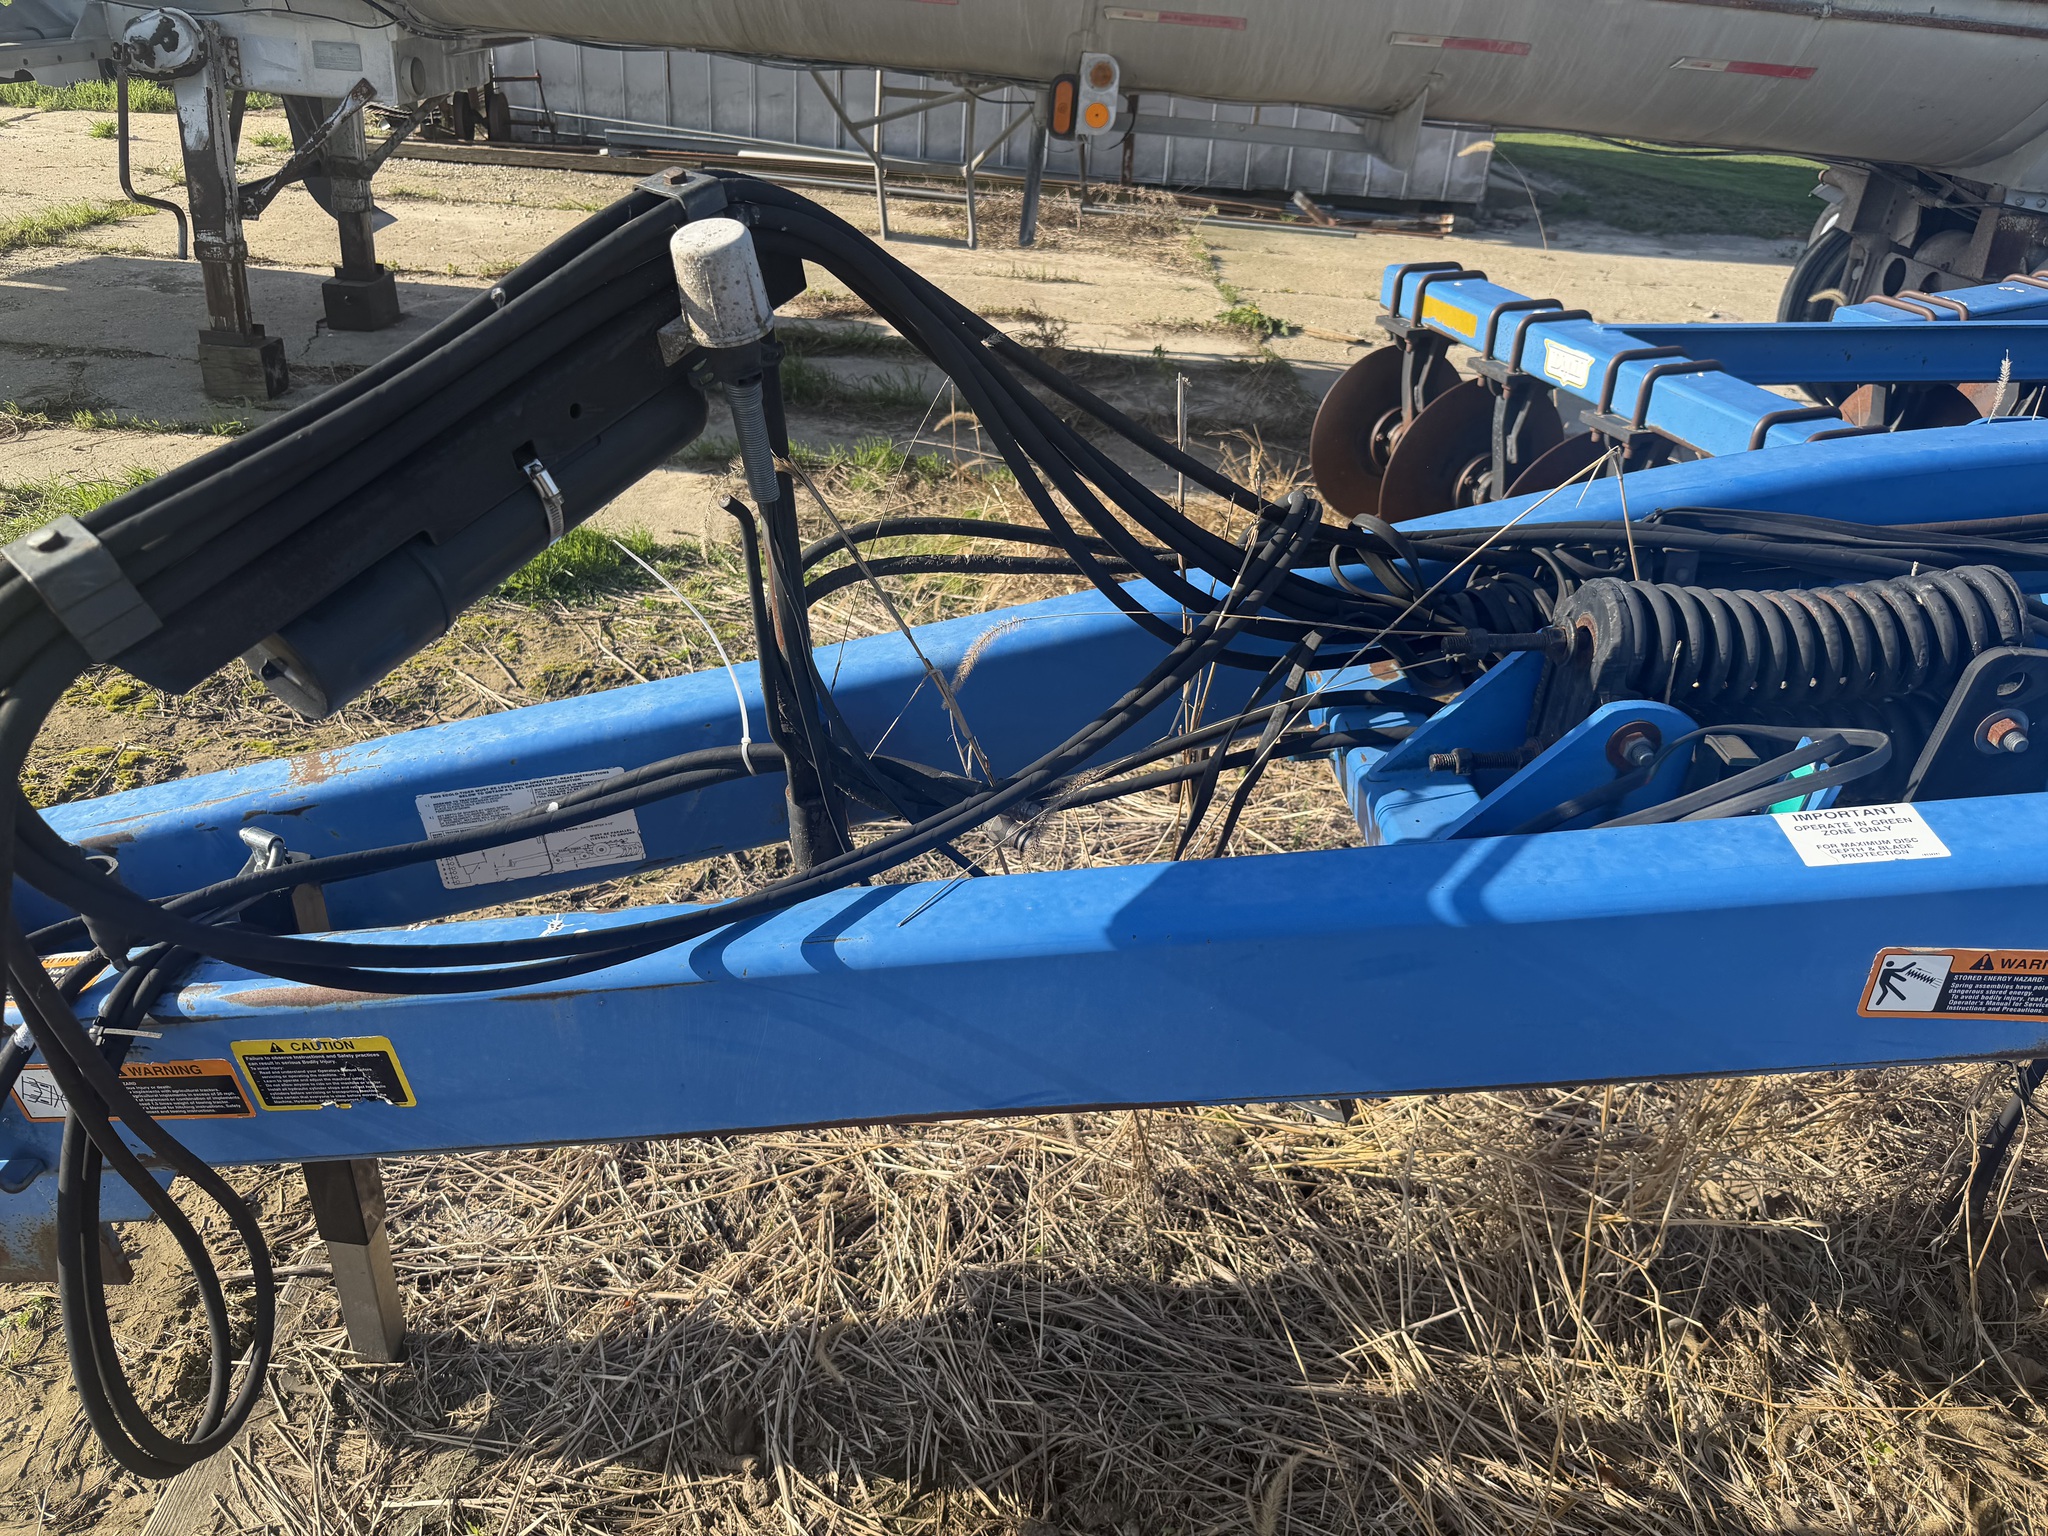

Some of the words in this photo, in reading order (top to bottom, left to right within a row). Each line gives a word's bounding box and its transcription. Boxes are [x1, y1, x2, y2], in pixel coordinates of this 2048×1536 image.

[1792, 807, 1897, 822] IMPORTANT
[1794, 821, 1851, 831] OPERATE
[1870, 816, 1912, 825] GREEN
[1822, 828, 1856, 836] ZONE
[1859, 825, 1893, 833] ONLY
[1840, 839, 1890, 848] MAXIMUM
[1893, 836, 1918, 844] DISC
[1842, 848, 1909, 859] PROTECTION
[290, 1041, 355, 1052] CAUTION
[127, 1065, 202, 1076] WARNING
